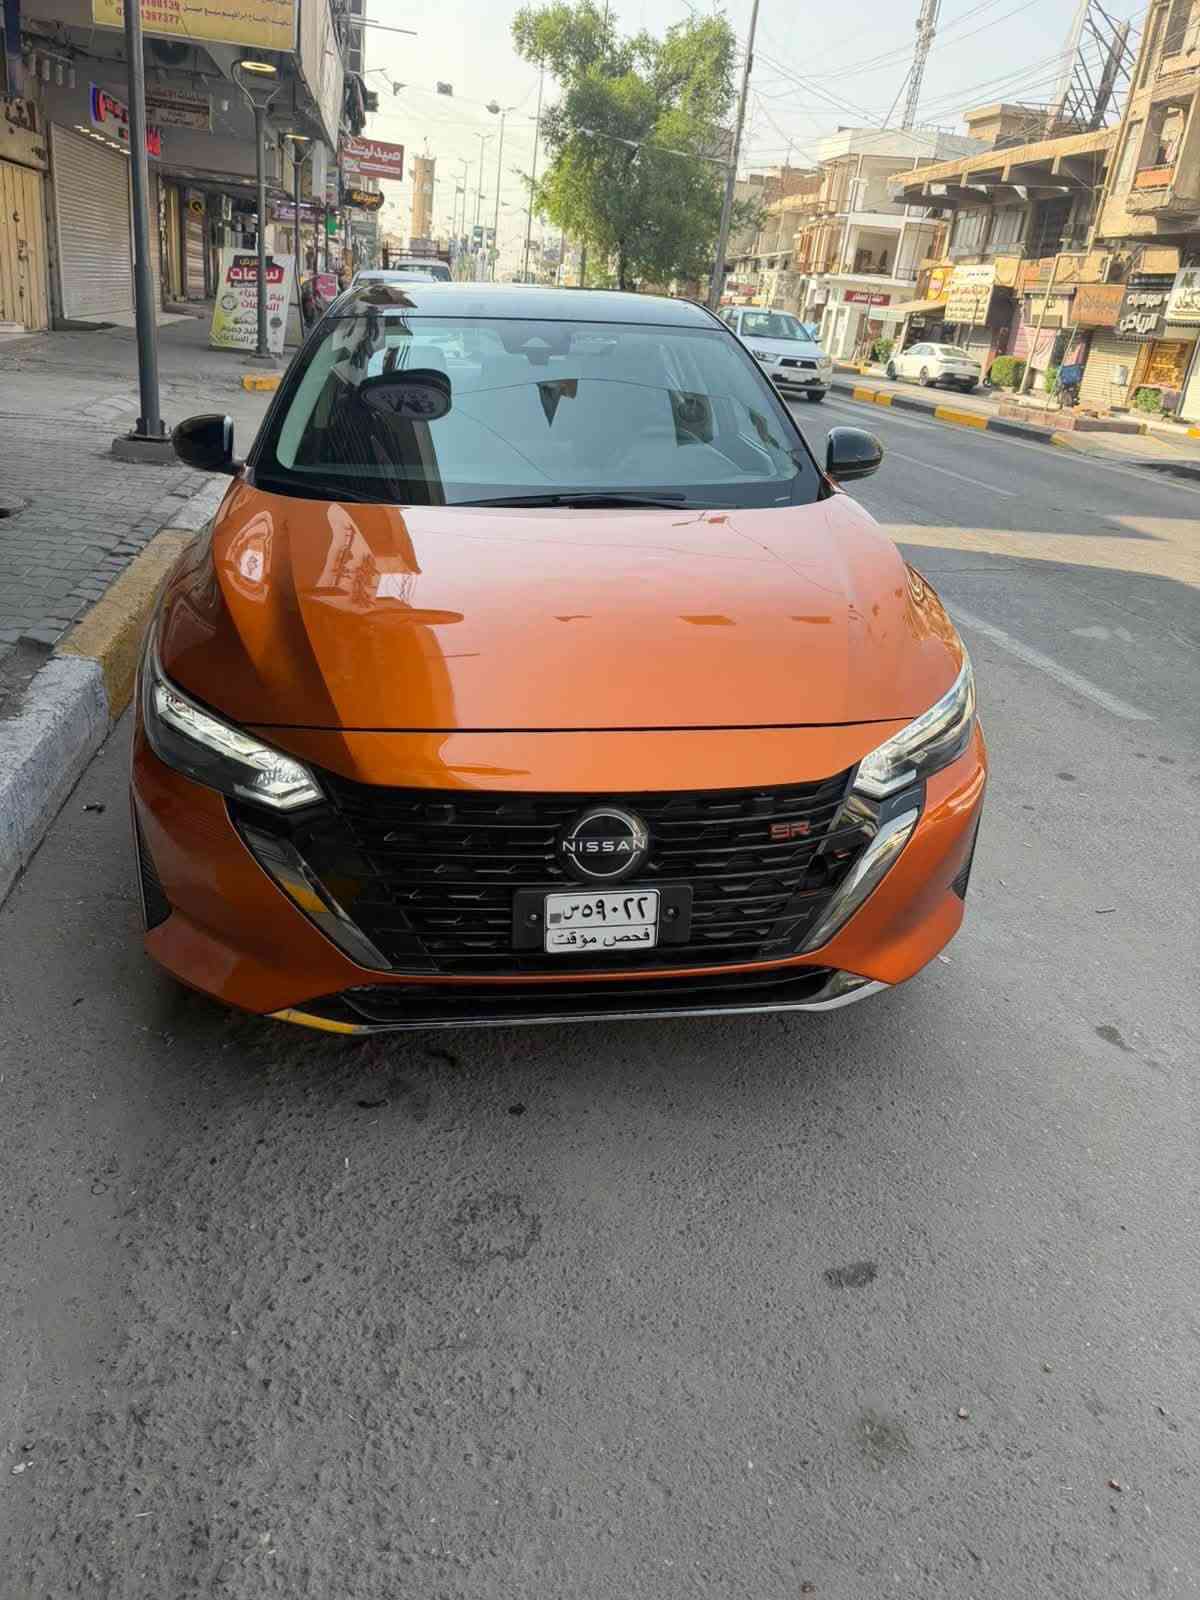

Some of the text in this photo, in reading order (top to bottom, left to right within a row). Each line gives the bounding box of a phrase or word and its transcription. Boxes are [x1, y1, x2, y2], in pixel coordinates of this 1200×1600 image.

[769, 820, 811, 840] SR
[562, 839, 646, 853] NISSAN
[603, 928, 650, 947] فحص
